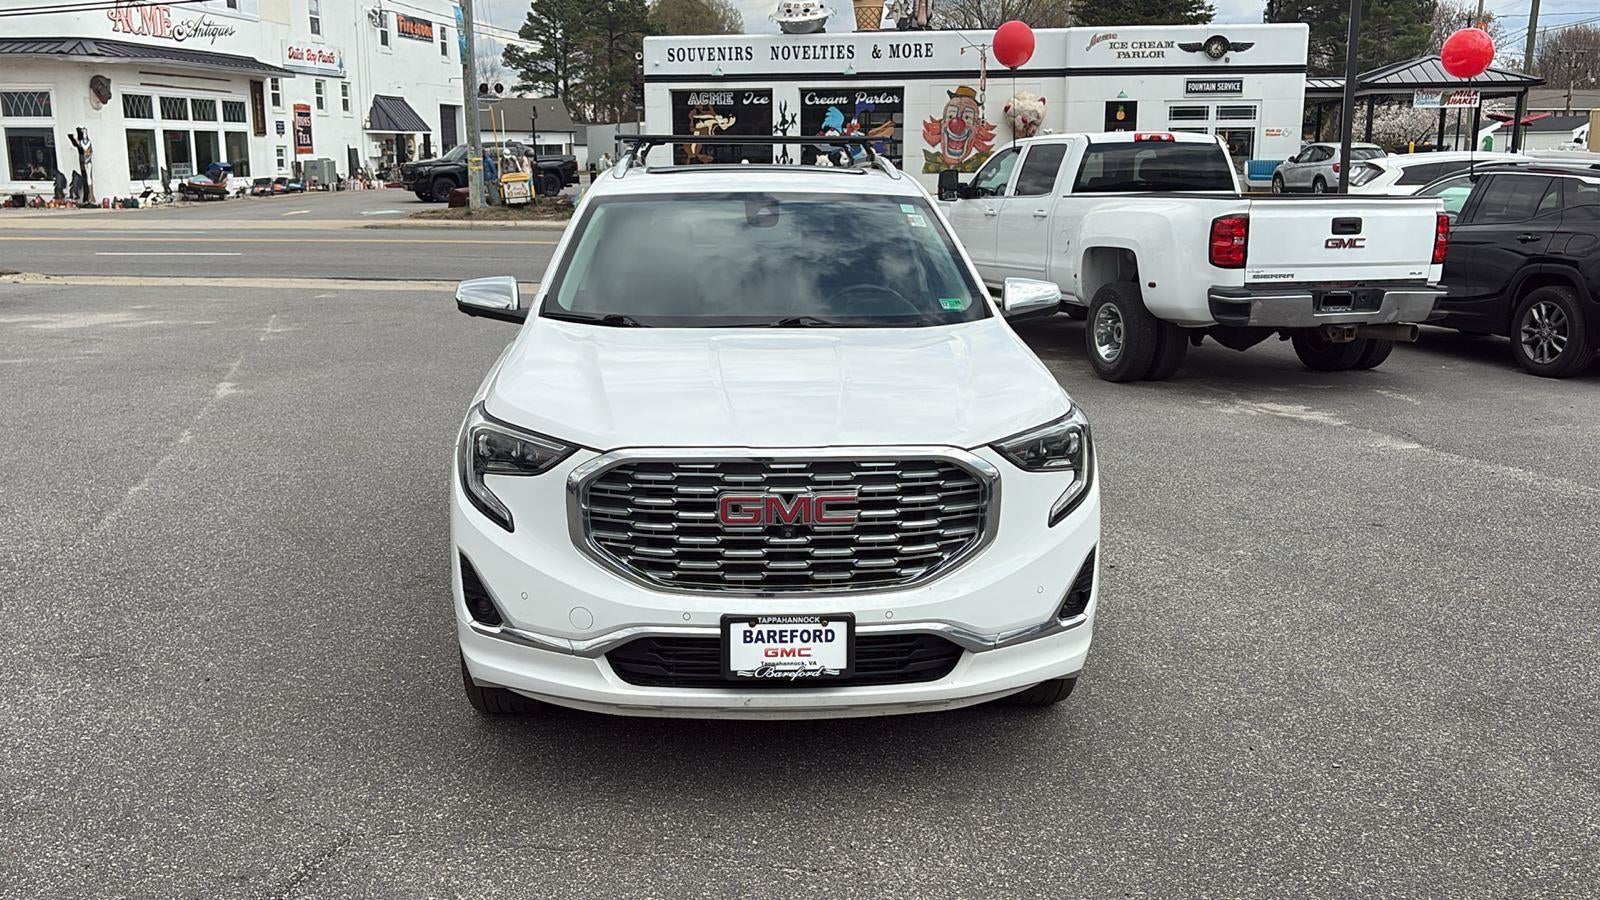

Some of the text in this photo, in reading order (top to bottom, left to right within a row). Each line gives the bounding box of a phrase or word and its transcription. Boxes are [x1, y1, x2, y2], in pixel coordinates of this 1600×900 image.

[107, 0, 235, 45] ACME Antiques
[1109, 41, 1128, 49] ICE
[667, 43, 934, 62] SOUVENIRS NOVELTIES & MORE
[1117, 50, 1165, 58] PARLOR
[1188, 82, 1241, 91] FOUNTAIN SERVICE
[687, 92, 770, 105] ACME Ice
[804, 91, 901, 105] Cream Parlor
[1325, 238, 1366, 249] GMC
[717, 492, 858, 526] GMC
[742, 629, 836, 644] BAREFORD
[764, 648, 812, 658] GMC
[754, 666, 825, 681] Bareford
